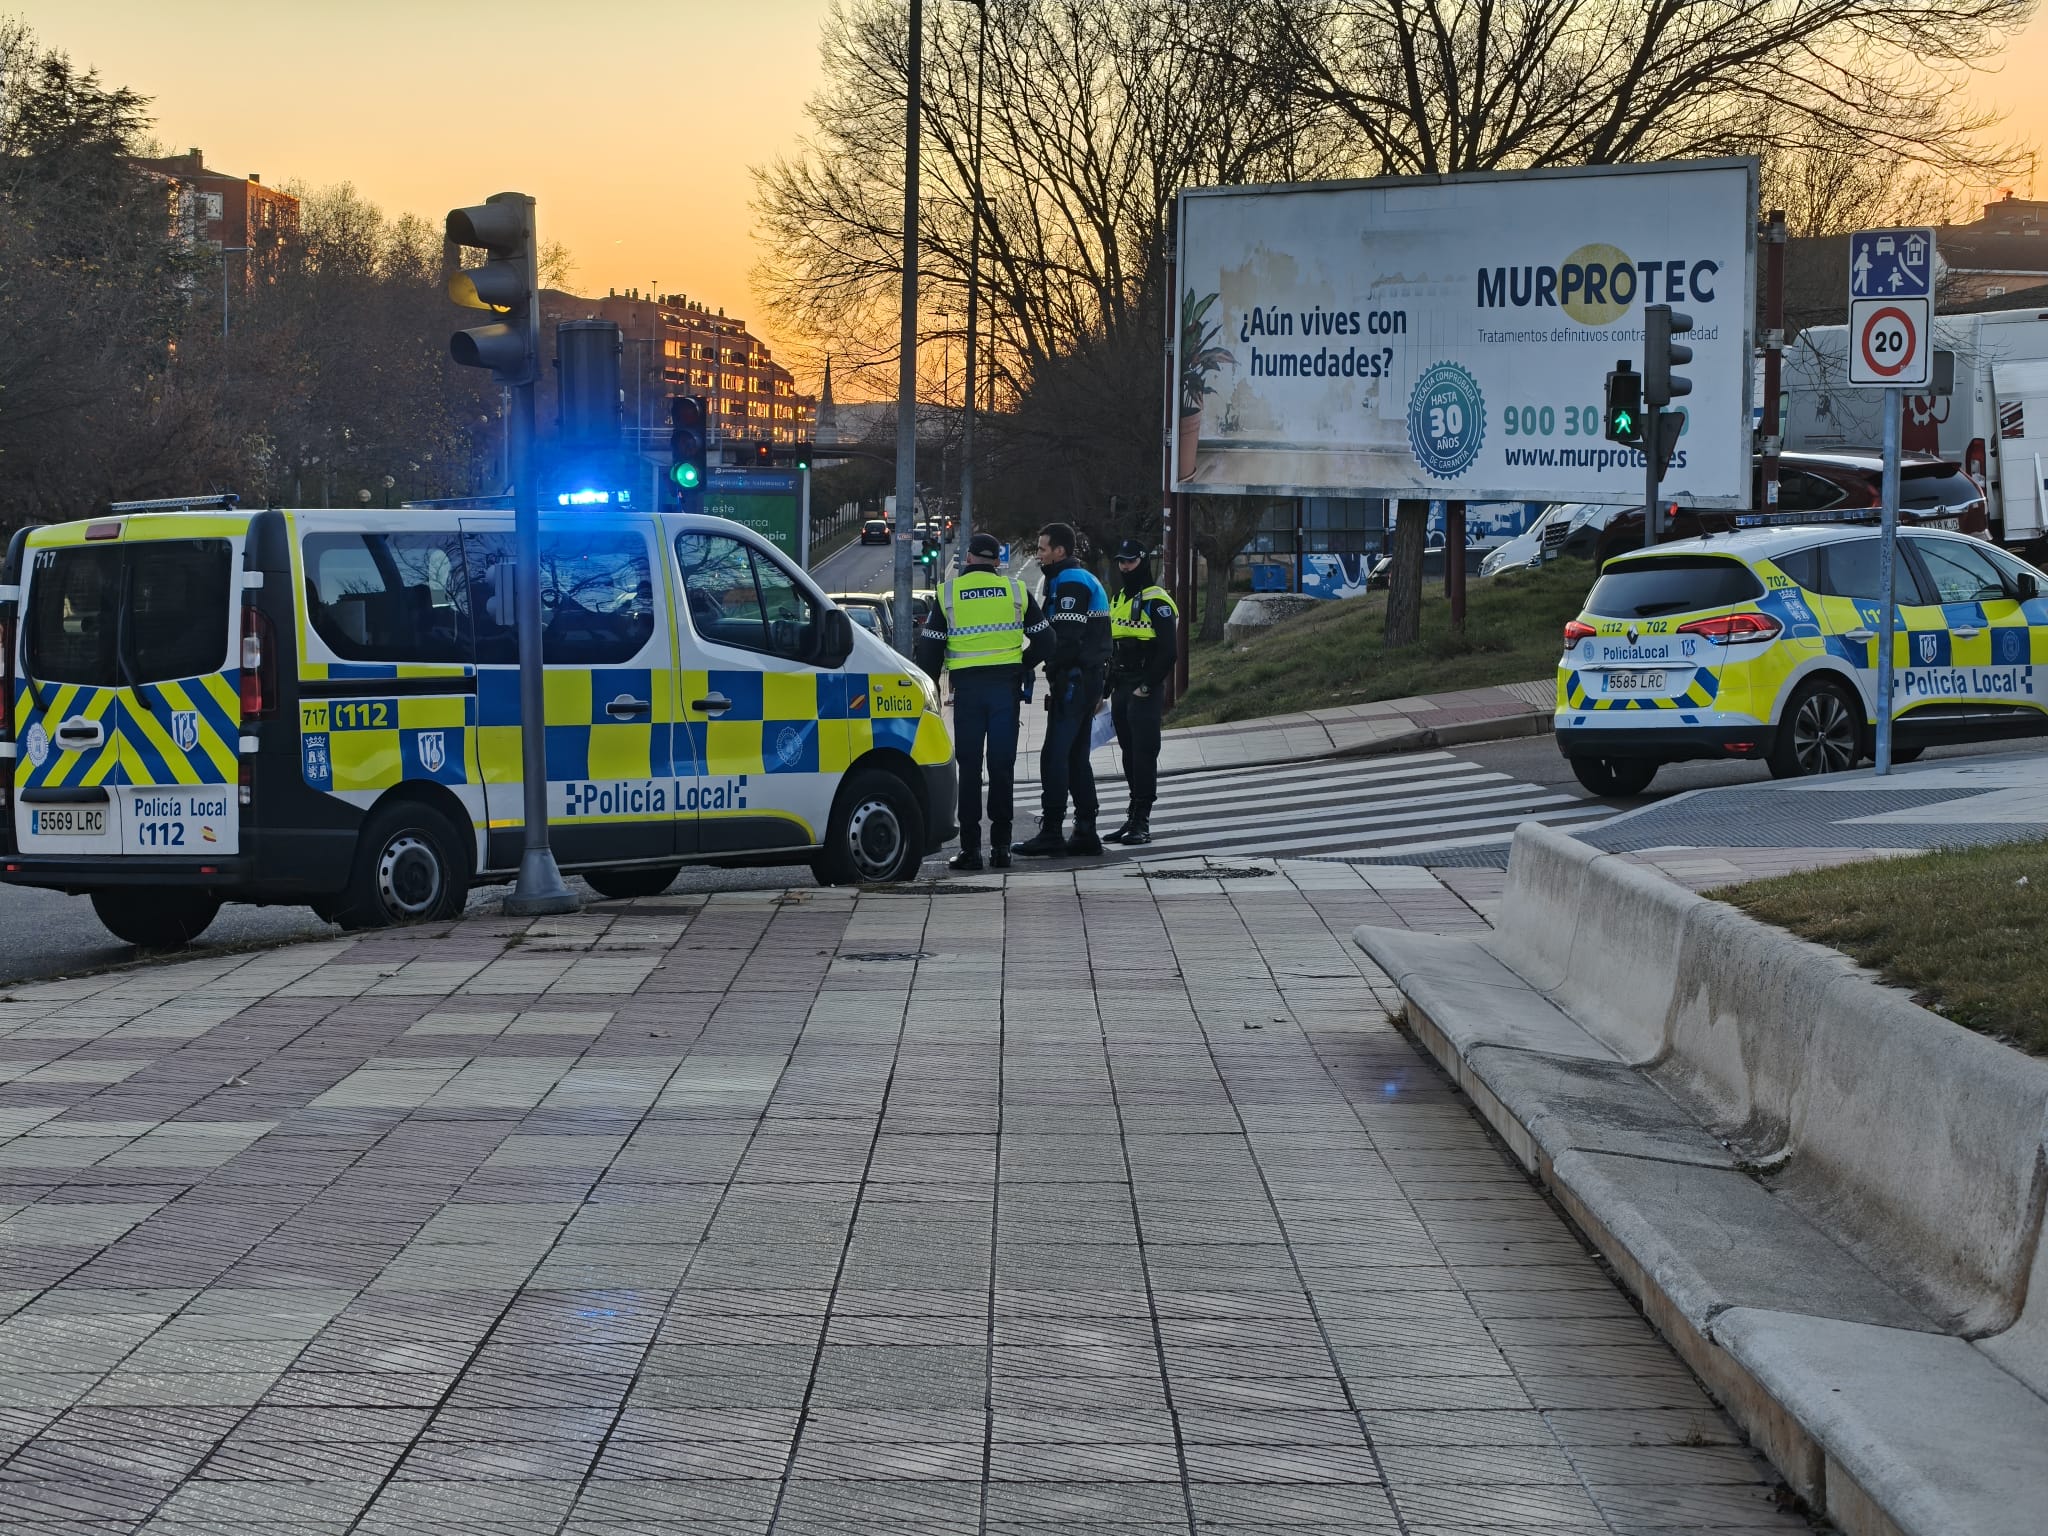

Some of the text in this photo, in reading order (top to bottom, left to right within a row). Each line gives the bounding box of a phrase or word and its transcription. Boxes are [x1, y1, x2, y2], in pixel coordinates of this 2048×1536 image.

[1477, 260, 1719, 308] MURPROTEC
[1240, 306, 1407, 342] ¿Aún vives con
[1478, 325, 1718, 343] Tratamientos definitivos contra umedad
[1875, 331, 1903, 352] 20
[1251, 347, 1394, 378] humedades?
[1431, 392, 1458, 406] HASTA
[1430, 404, 1463, 438] 30
[1503, 406, 1599, 436] 900 30
[1437, 436, 1460, 450] AÑOS
[1429, 455, 1438, 467] DE
[1505, 448, 1687, 472] www.murprotees
[712, 504, 735, 513] este
[36, 551, 57, 569] 717
[1766, 575, 1789, 588] 702
[1606, 621, 1668, 633] 112 702
[1609, 674, 1663, 689] 5585 LRC
[1905, 668, 2018, 696] Policía Local
[876, 695, 913, 712] Policía
[303, 703, 388, 727] 717 112
[135, 797, 227, 817] Policía Local
[583, 780, 732, 814] Policía Local
[40, 811, 103, 832] 5569 LRC
[146, 822, 185, 846] 112
